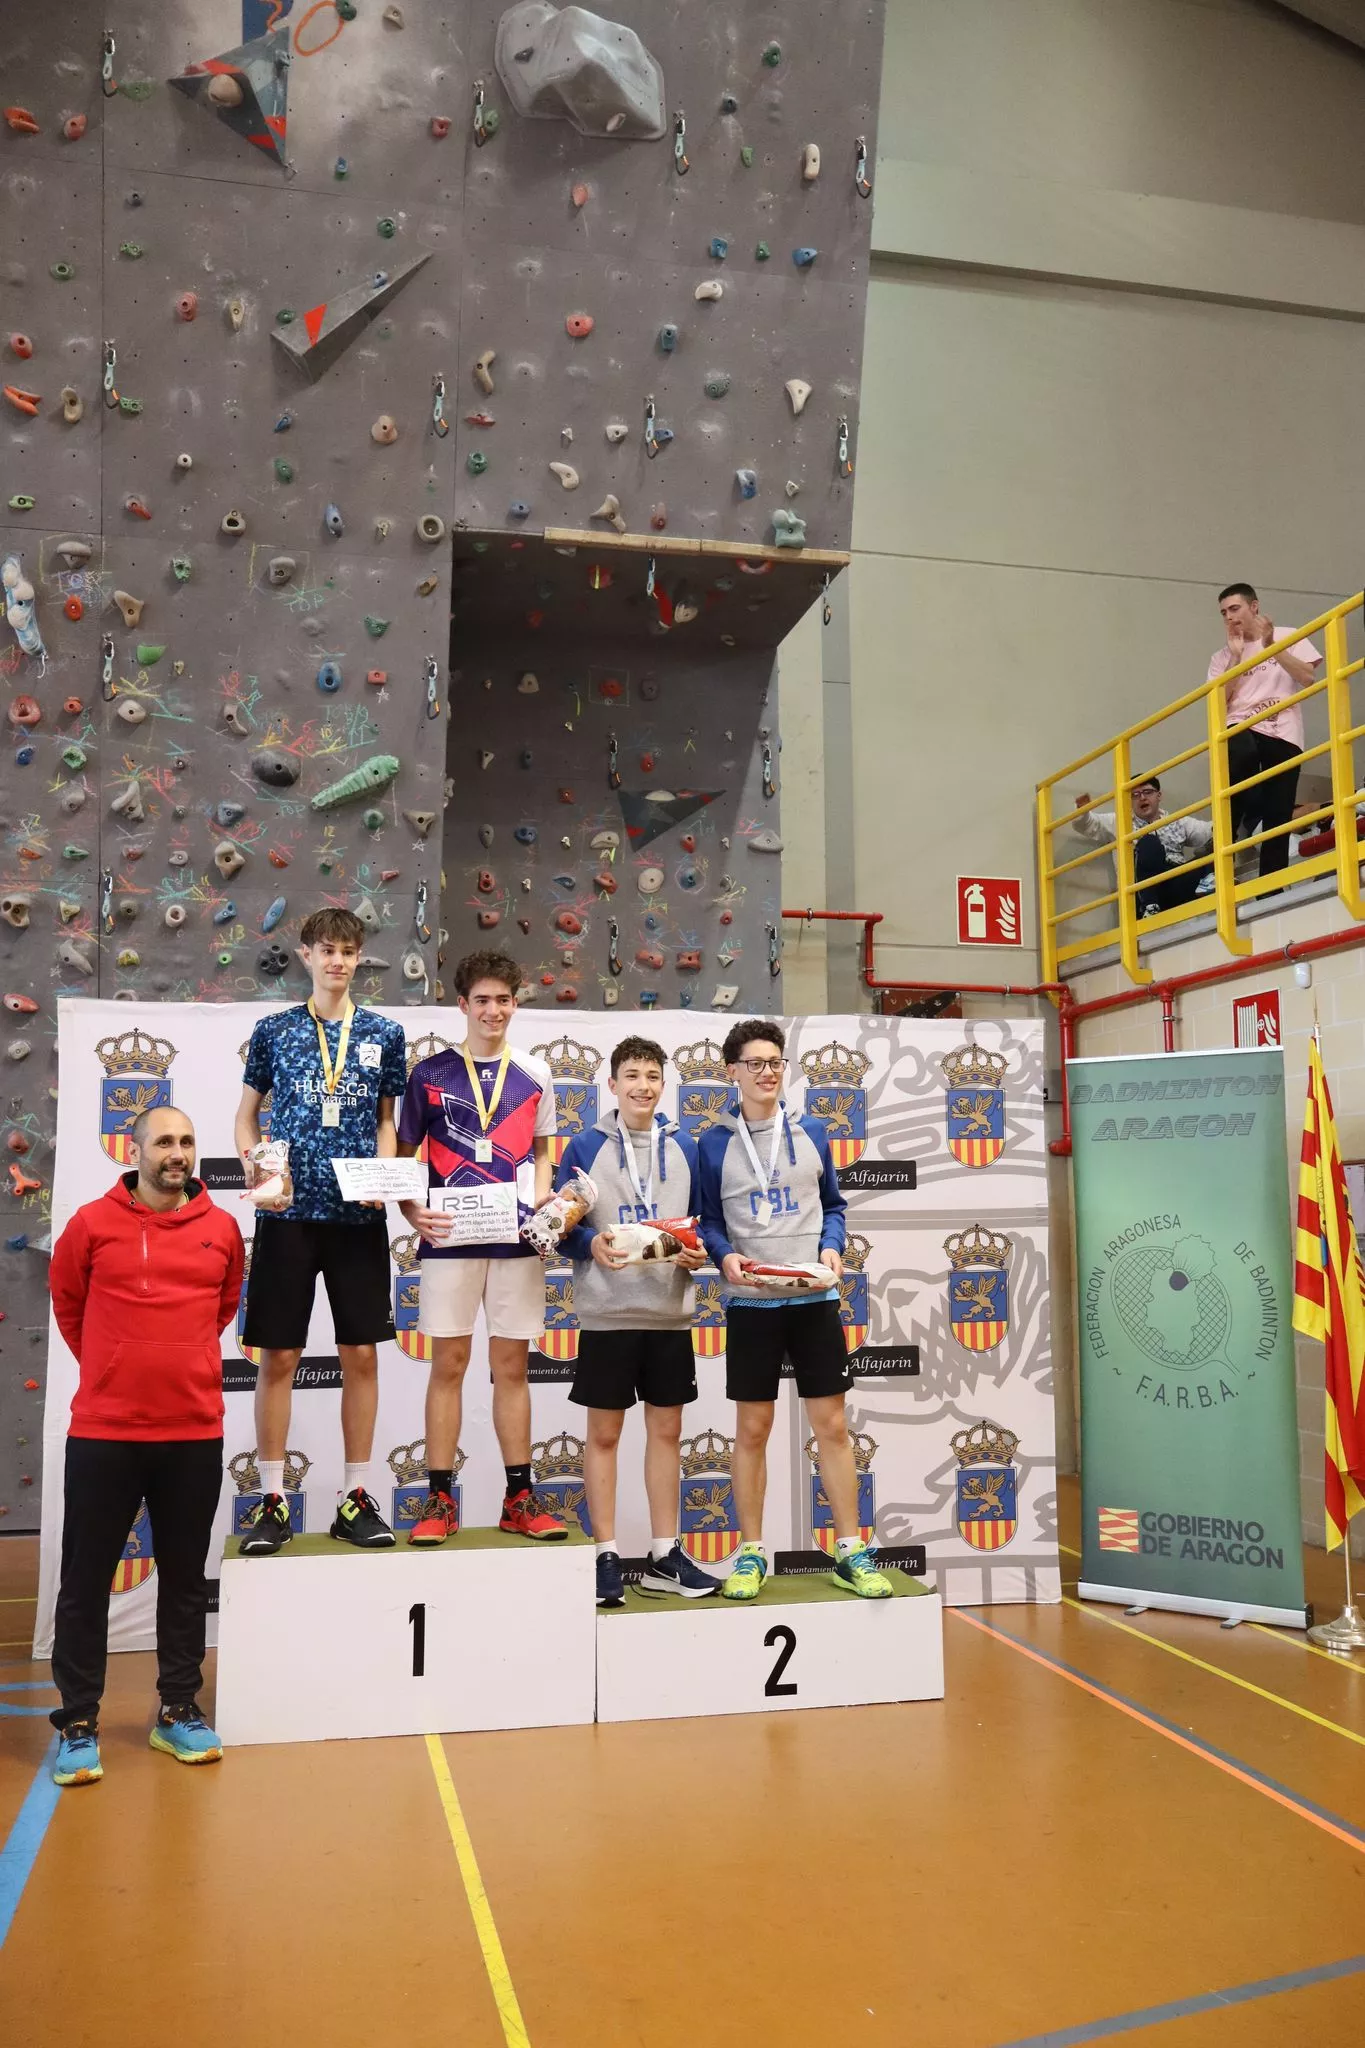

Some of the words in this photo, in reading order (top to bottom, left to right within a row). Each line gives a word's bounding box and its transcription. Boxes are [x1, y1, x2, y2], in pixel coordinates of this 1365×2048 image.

[1070, 1074, 1283, 1105] BADMINTON
[1091, 1112, 1257, 1142] ARAGON
[845, 1169, 910, 1186] Alfajarín
[442, 1194, 494, 1211] RSL
[1103, 1213, 1182, 1262] ARAGONESA
[1086, 1266, 1109, 1359] FEDERACION
[1233, 1241, 1256, 1265] DE
[1249, 1265, 1278, 1361] BADMINTON
[1136, 1375, 1239, 1409] F.A.R.B.A.
[1140, 1511, 1265, 1543] GOBIERNO
[1141, 1535, 1172, 1557] DE
[1180, 1538, 1284, 1569] ARAGON
[408, 1603, 427, 1677] 1
[763, 1624, 798, 1697] 2
